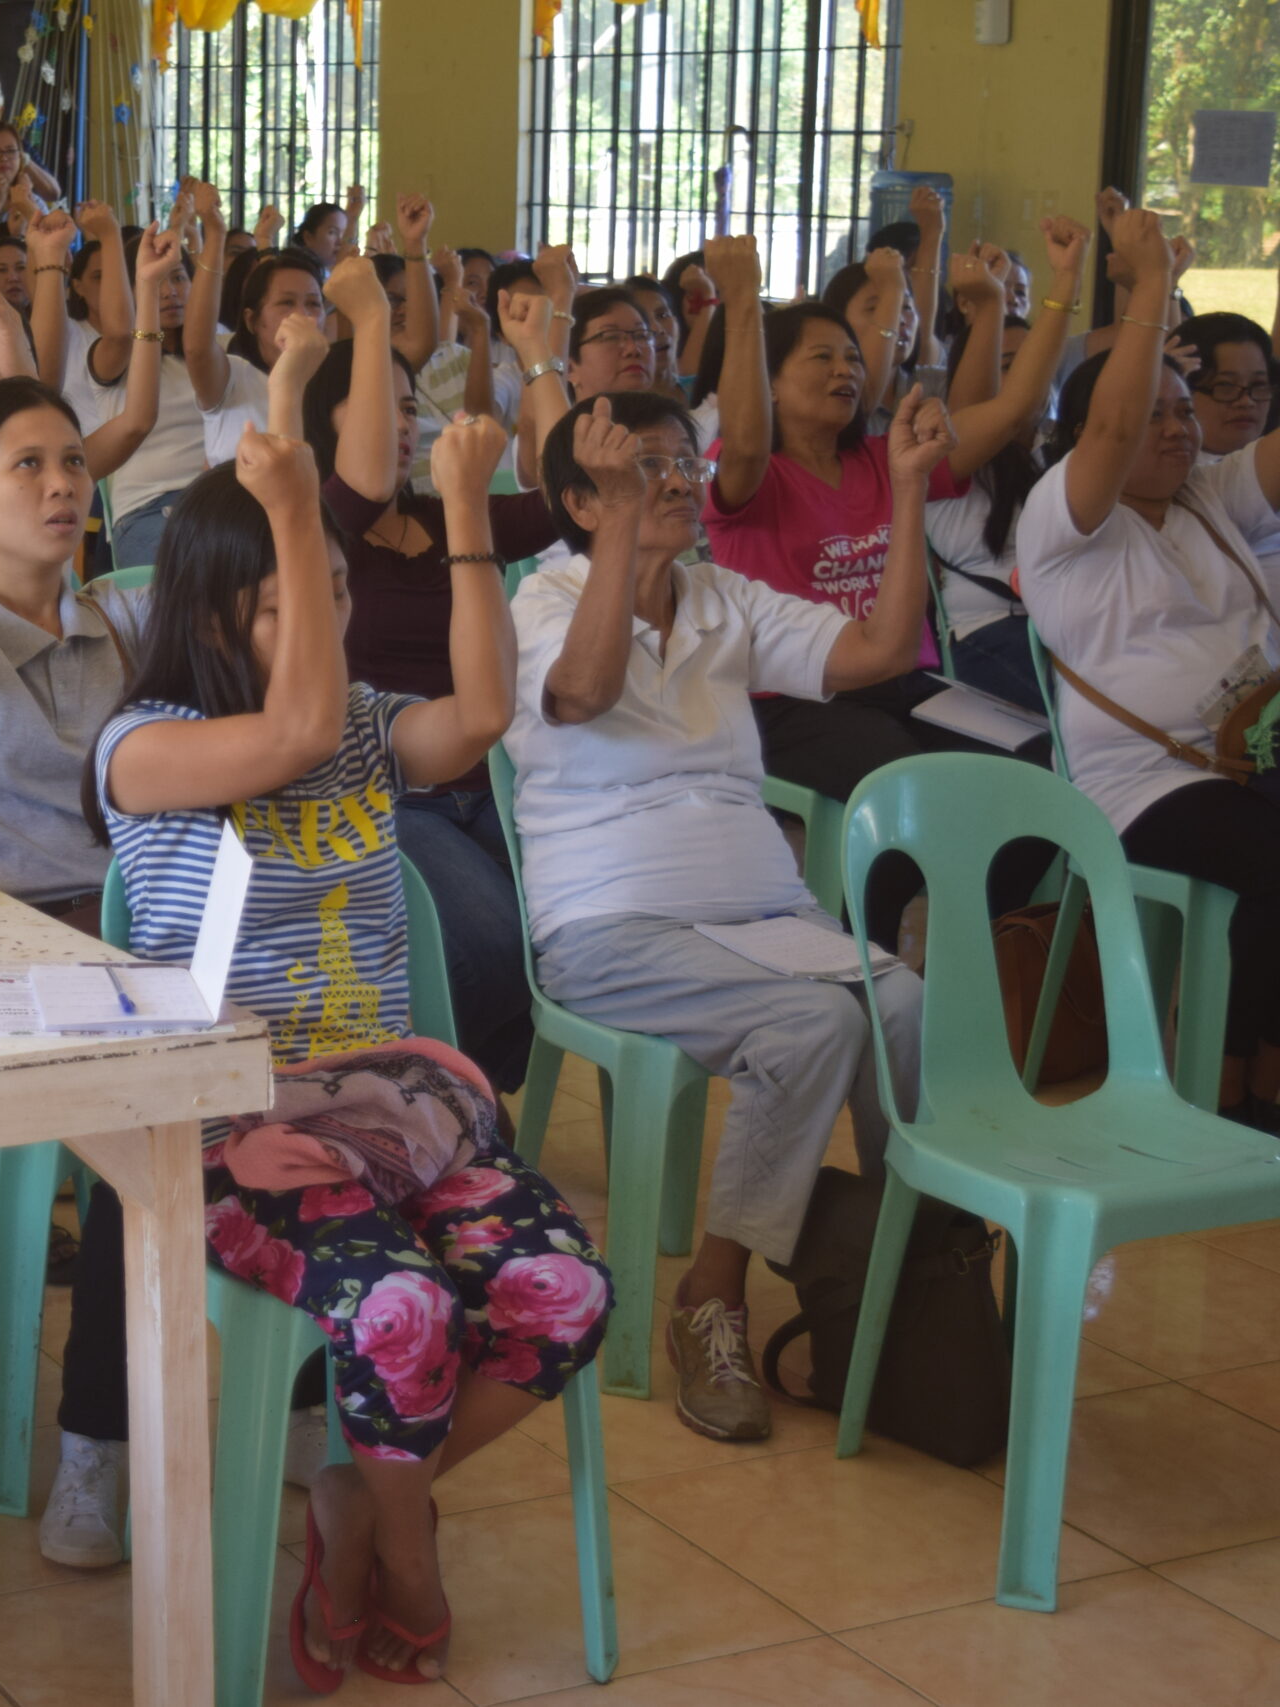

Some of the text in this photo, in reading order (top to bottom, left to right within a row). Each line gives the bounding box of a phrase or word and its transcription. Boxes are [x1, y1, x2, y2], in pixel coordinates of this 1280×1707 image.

[824, 529, 891, 560] WE MAK
[822, 575, 871, 595] WORK
